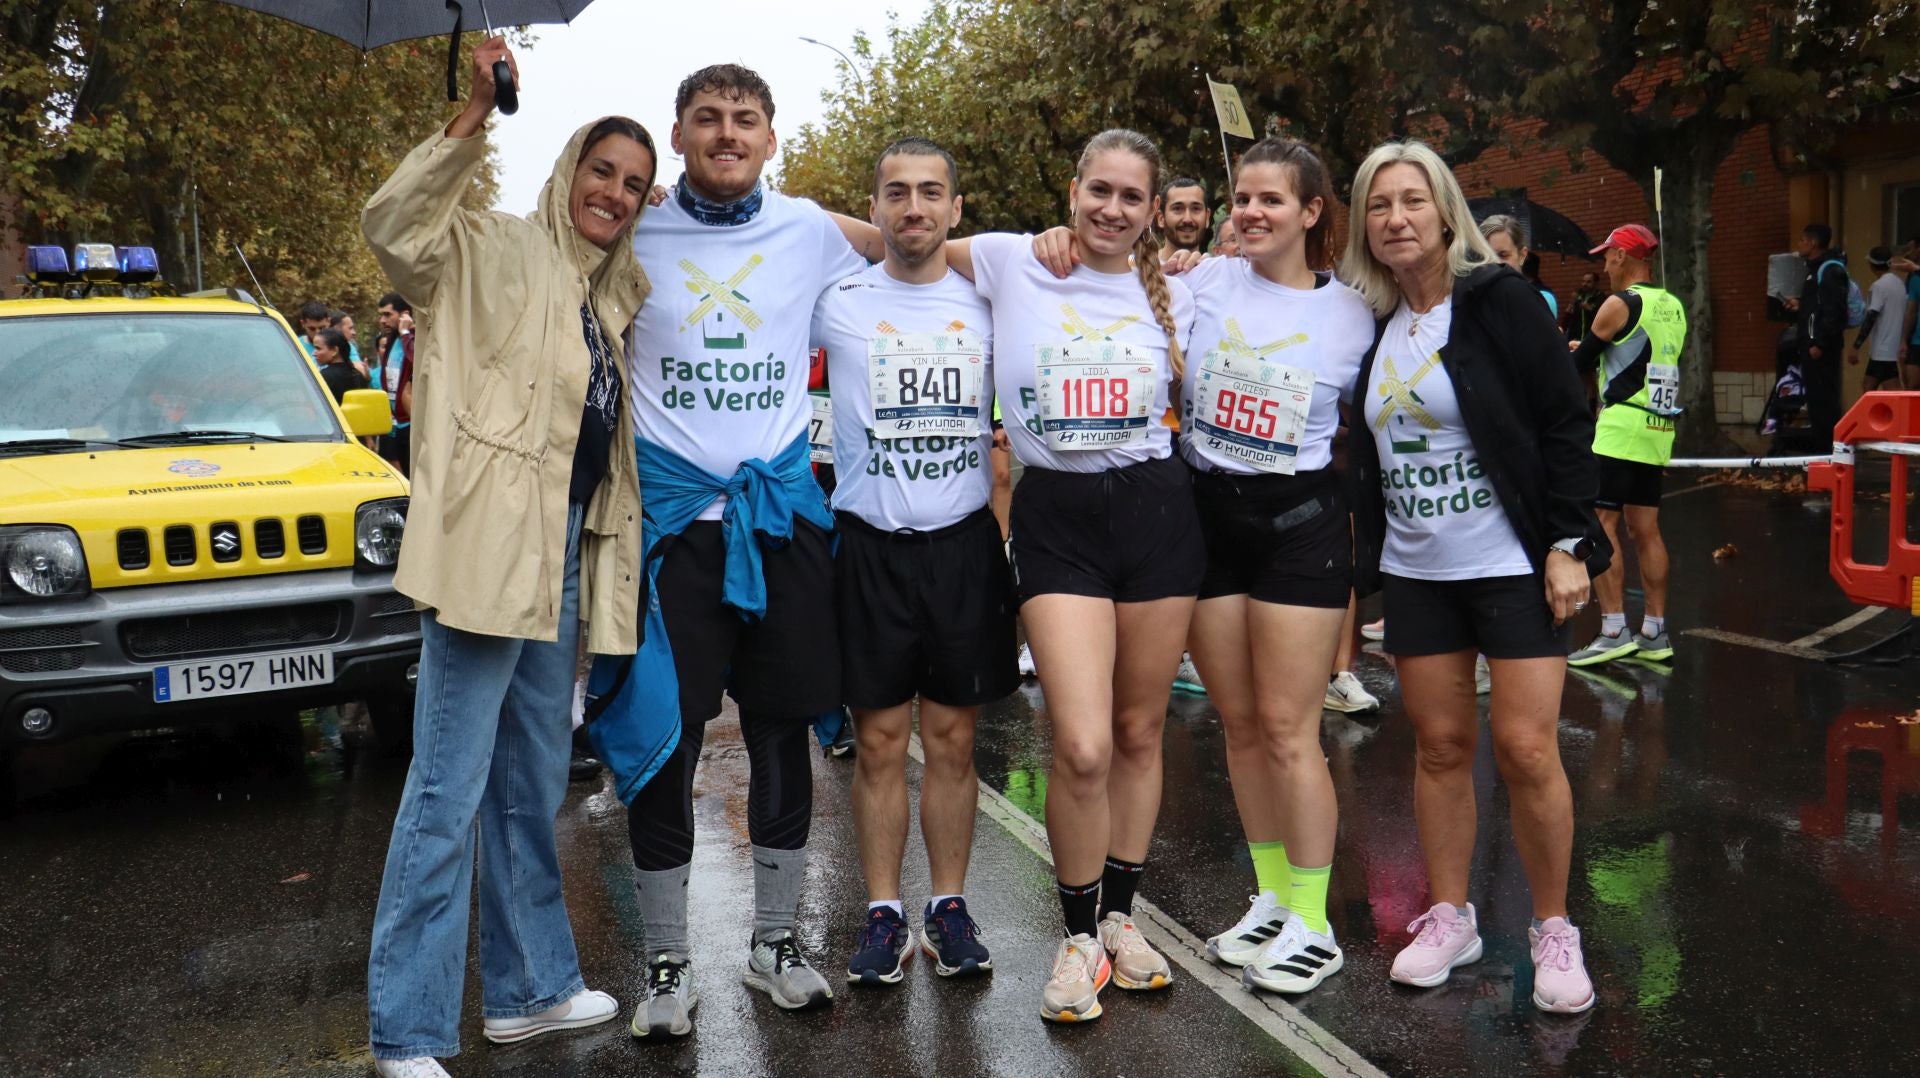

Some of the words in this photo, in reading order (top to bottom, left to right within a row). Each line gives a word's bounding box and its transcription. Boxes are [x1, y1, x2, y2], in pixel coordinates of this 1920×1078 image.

[660, 352, 786, 383] Factoría
[912, 357, 928, 365] YIN
[932, 357, 948, 365] LEE
[1082, 367, 1110, 376] LIDIA
[661, 385, 696, 410] de
[703, 385, 785, 412] Verde
[898, 368, 961, 405] 840
[1062, 378, 1129, 417] 1108
[918, 419, 966, 428] HYUNDAI
[1215, 389, 1280, 439] 955
[1081, 431, 1131, 441] HYUNDAI
[866, 452, 896, 478] de
[902, 450, 979, 481] Verde
[1225, 443, 1277, 464] HYUNDAI
[128, 482, 234, 496] Ayuntamiento
[237, 480, 255, 488] de
[1399, 486, 1491, 519] Verde
[182, 661, 255, 694] 1597
[269, 654, 325, 685] HNN
[159, 687, 167, 695] E
